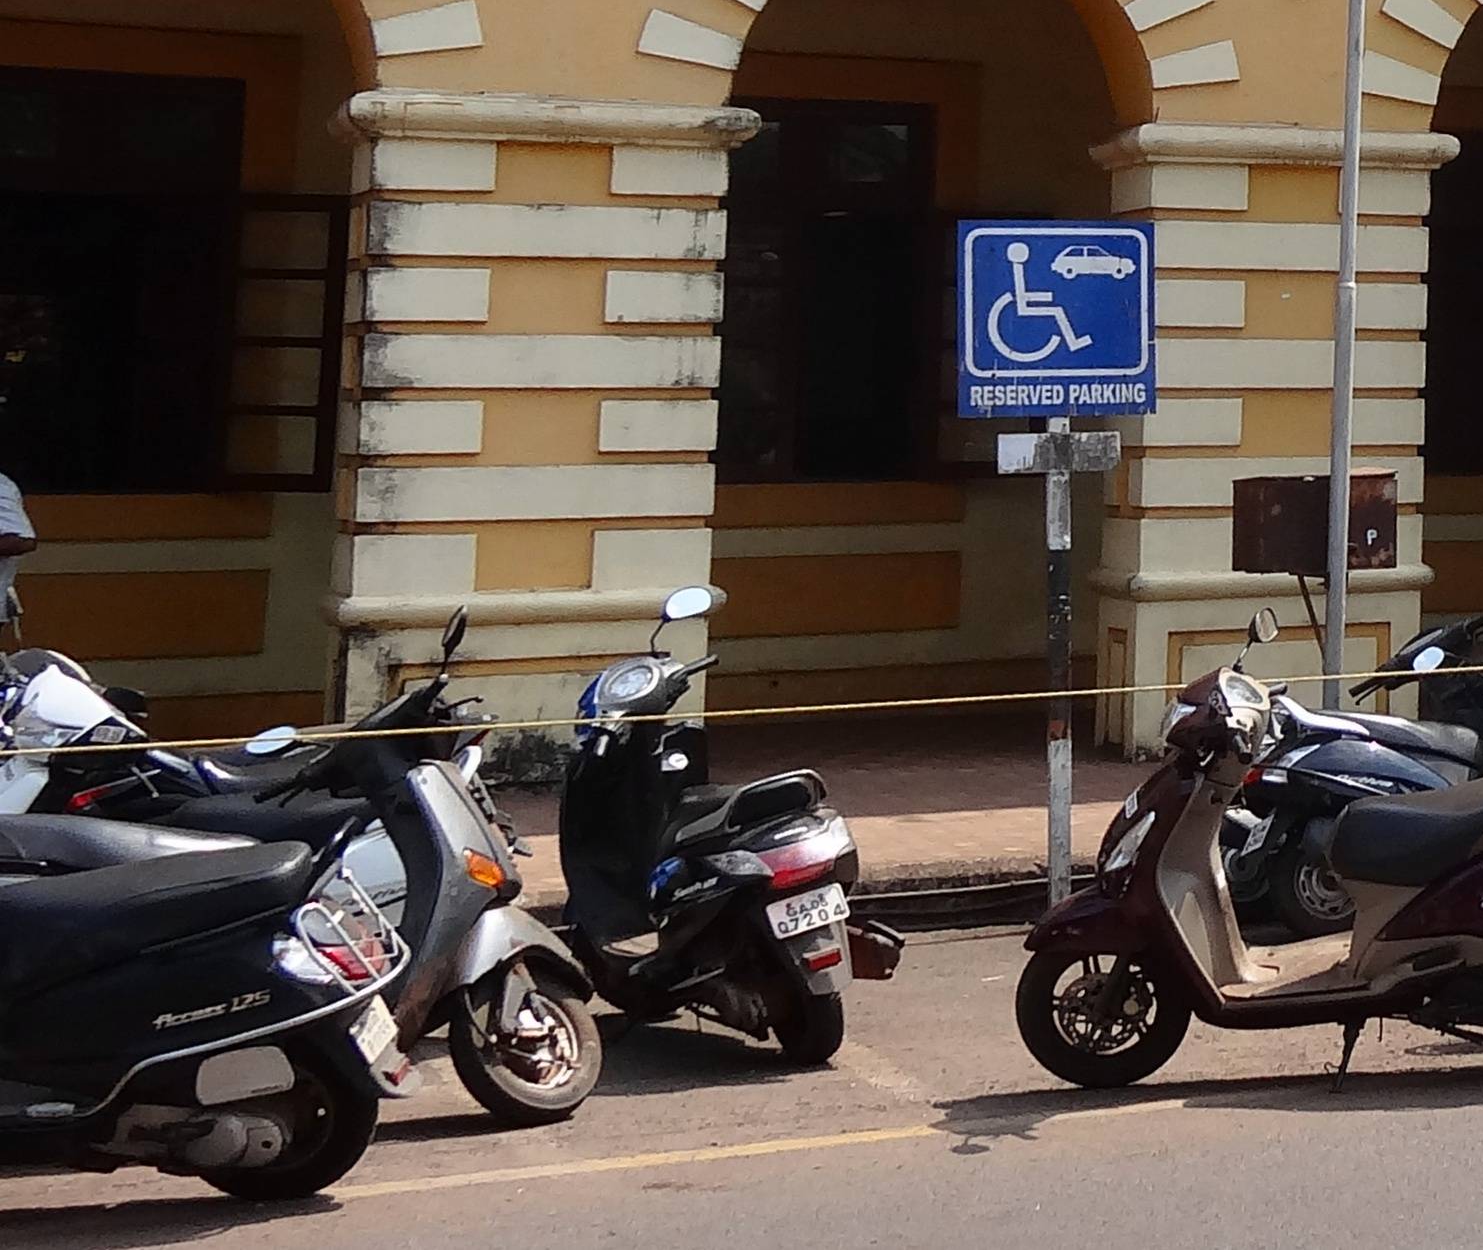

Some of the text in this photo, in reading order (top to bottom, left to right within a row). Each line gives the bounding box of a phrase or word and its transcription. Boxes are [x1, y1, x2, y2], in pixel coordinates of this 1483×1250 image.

[969, 382, 1147, 407] RESERVED PARKING
[230, 989, 272, 1013] 125
